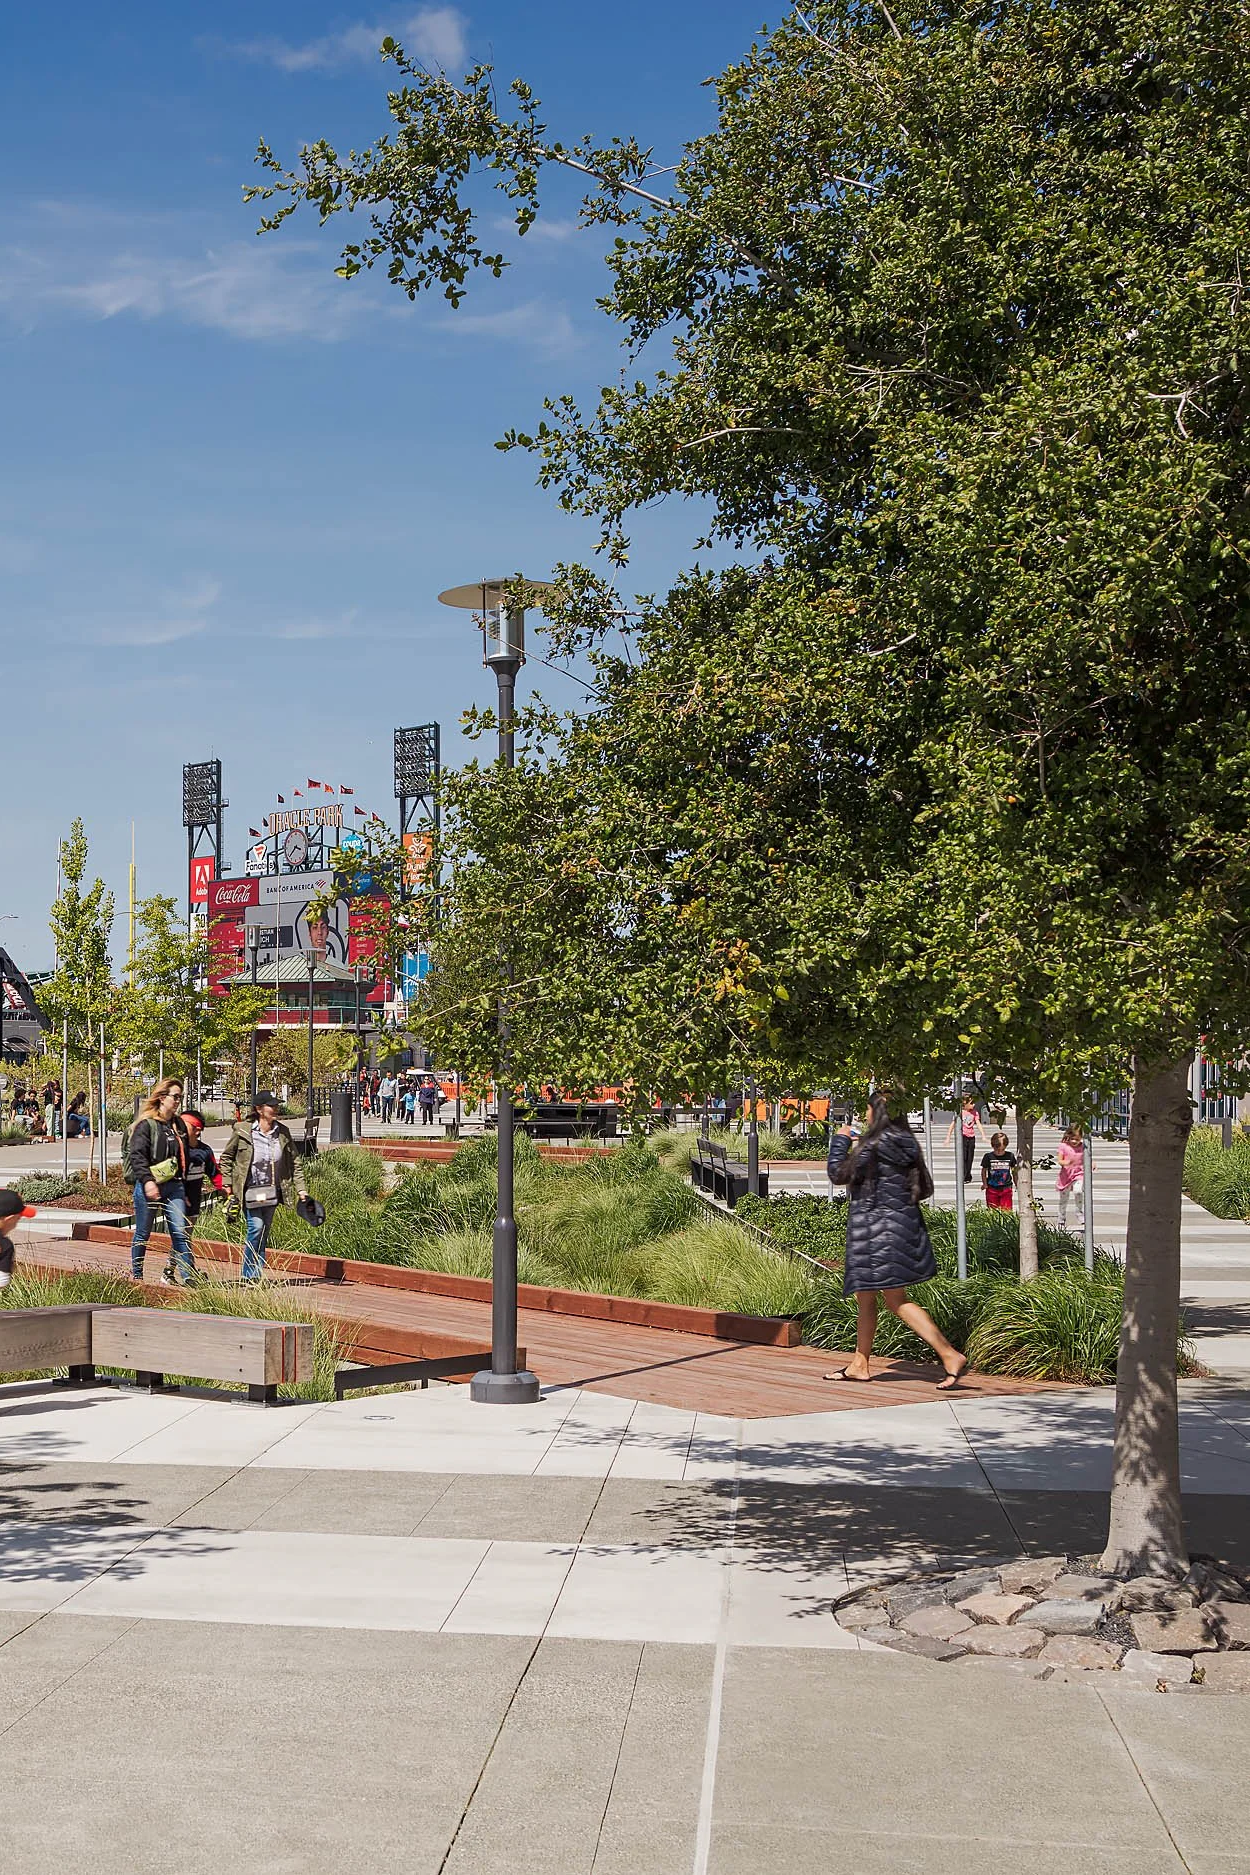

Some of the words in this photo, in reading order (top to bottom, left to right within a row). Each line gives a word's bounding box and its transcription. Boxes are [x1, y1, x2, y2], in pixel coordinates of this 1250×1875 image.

[269, 809, 310, 835] ORACLE
[314, 804, 344, 827] PARK
[343, 840, 361, 848] coupa
[246, 860, 273, 872] Fanatis
[196, 887, 208, 896] Adob
[290, 883, 315, 891] AMERICA
[215, 884, 252, 905] Coca-Cola
